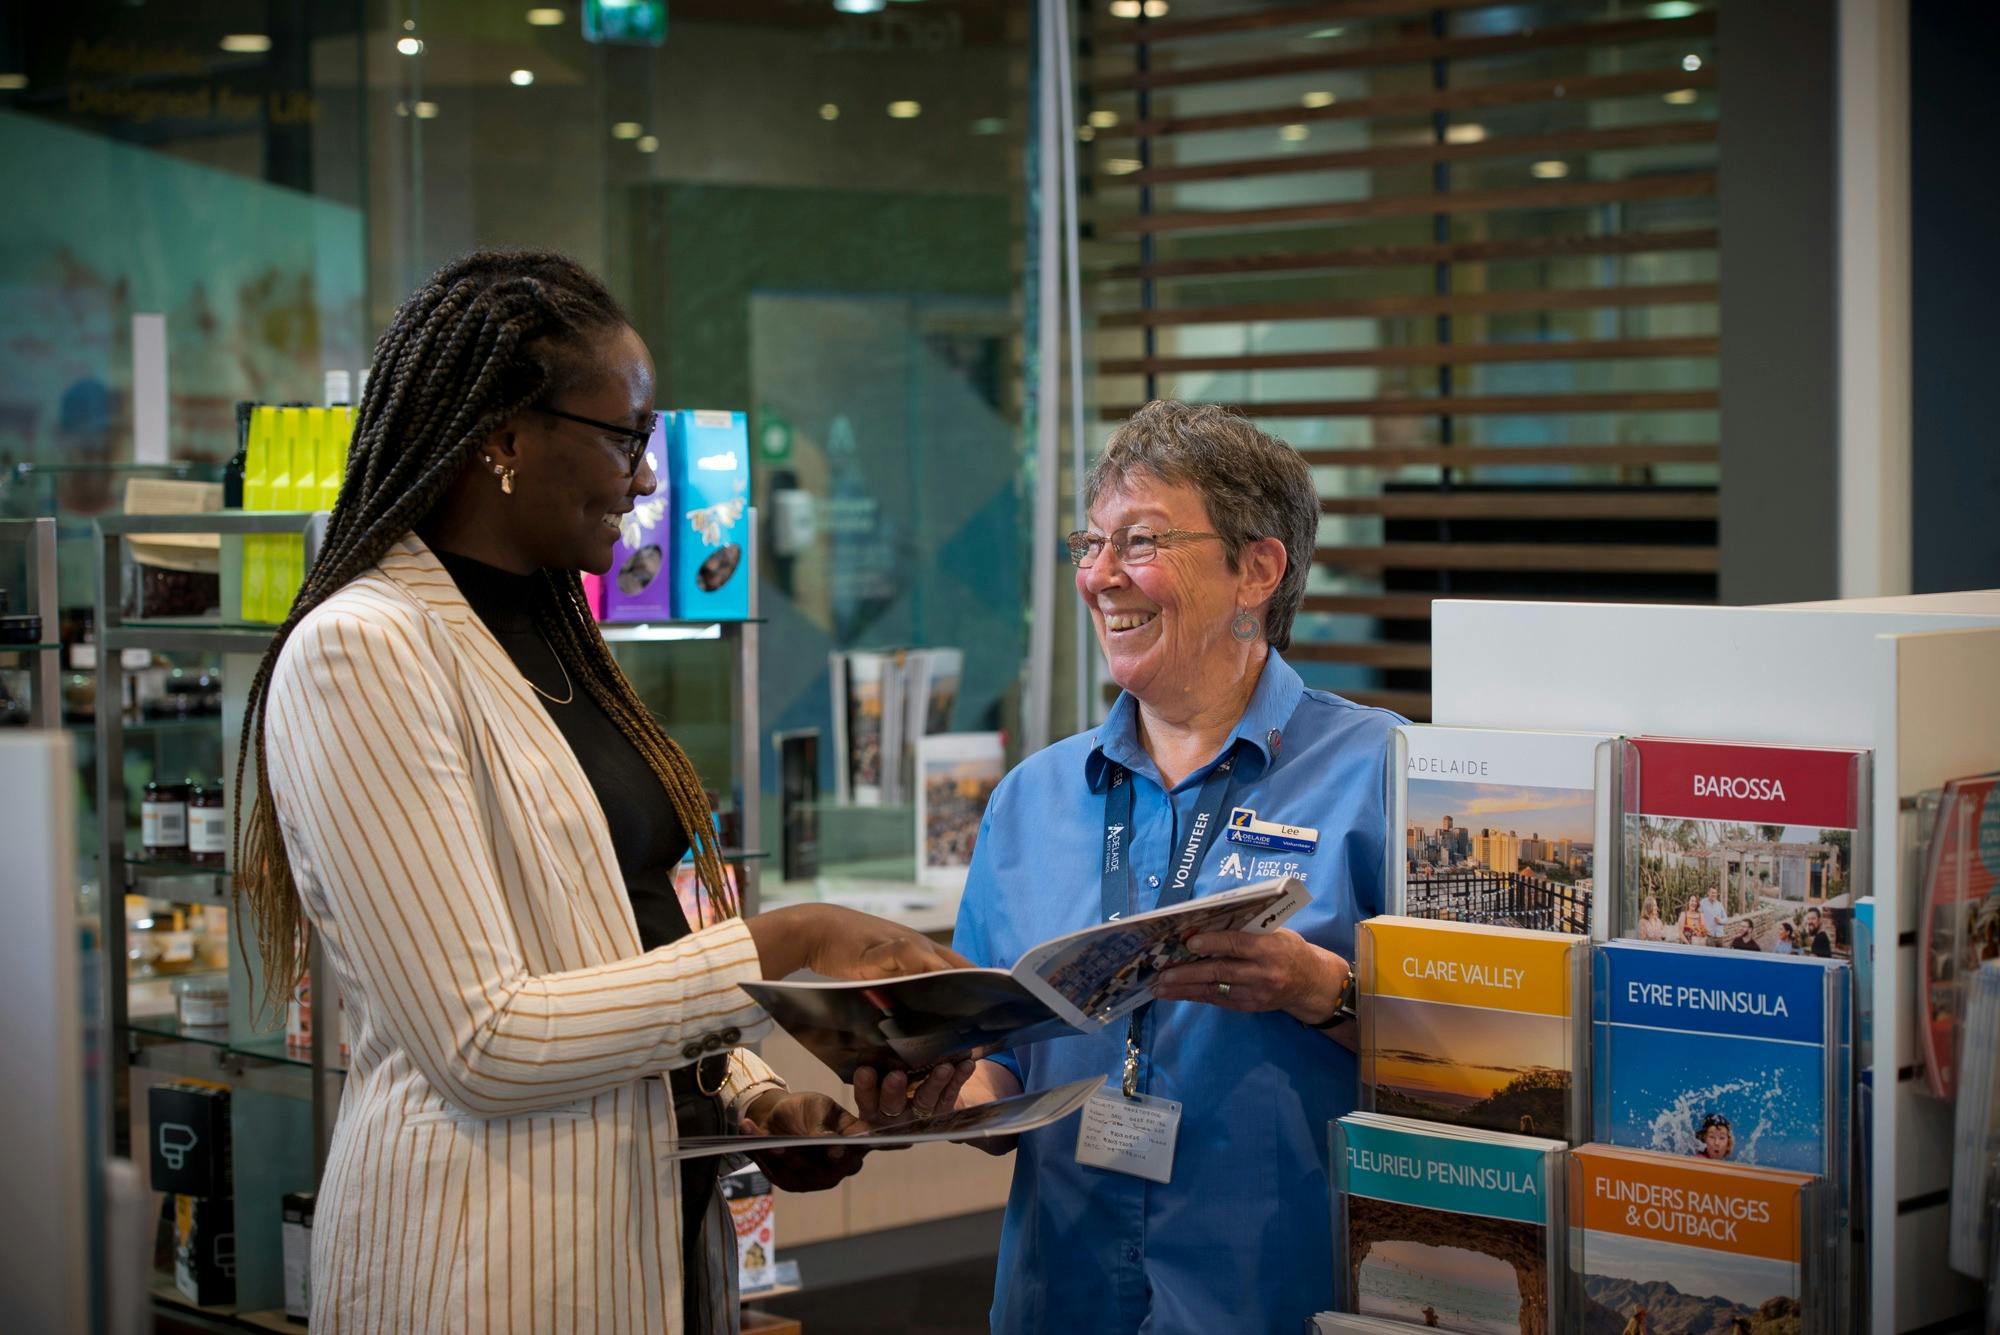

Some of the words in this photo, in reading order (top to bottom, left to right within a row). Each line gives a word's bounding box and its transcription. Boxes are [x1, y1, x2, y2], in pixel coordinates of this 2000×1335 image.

[1407, 757, 1489, 776] ADELAIDE
[1693, 774, 1787, 802] BAROSSA
[1281, 825, 1300, 836] Lee
[1282, 840, 1311, 849] Volunteer
[1107, 825, 1125, 872] ADELAIDE
[1172, 812, 1211, 889] VOLUNTEER
[1257, 860, 1281, 869] CITY
[1283, 861, 1299, 871] OF
[1255, 868, 1309, 882] ADELAIDE
[1402, 956, 1458, 983] CLARE
[1460, 962, 1526, 991] VALLEY
[1628, 981, 1673, 1008] EYRE
[1677, 986, 1789, 1018] PENINSULA
[1346, 1147, 1422, 1180] FLEURIEU
[1426, 1160, 1537, 1196] PENINSULA
[1595, 1176, 1684, 1211] FLINDERS
[1687, 1191, 1770, 1224] RANGES
[1625, 1205, 1641, 1227] &
[1643, 1208, 1738, 1243] OUTBACK
